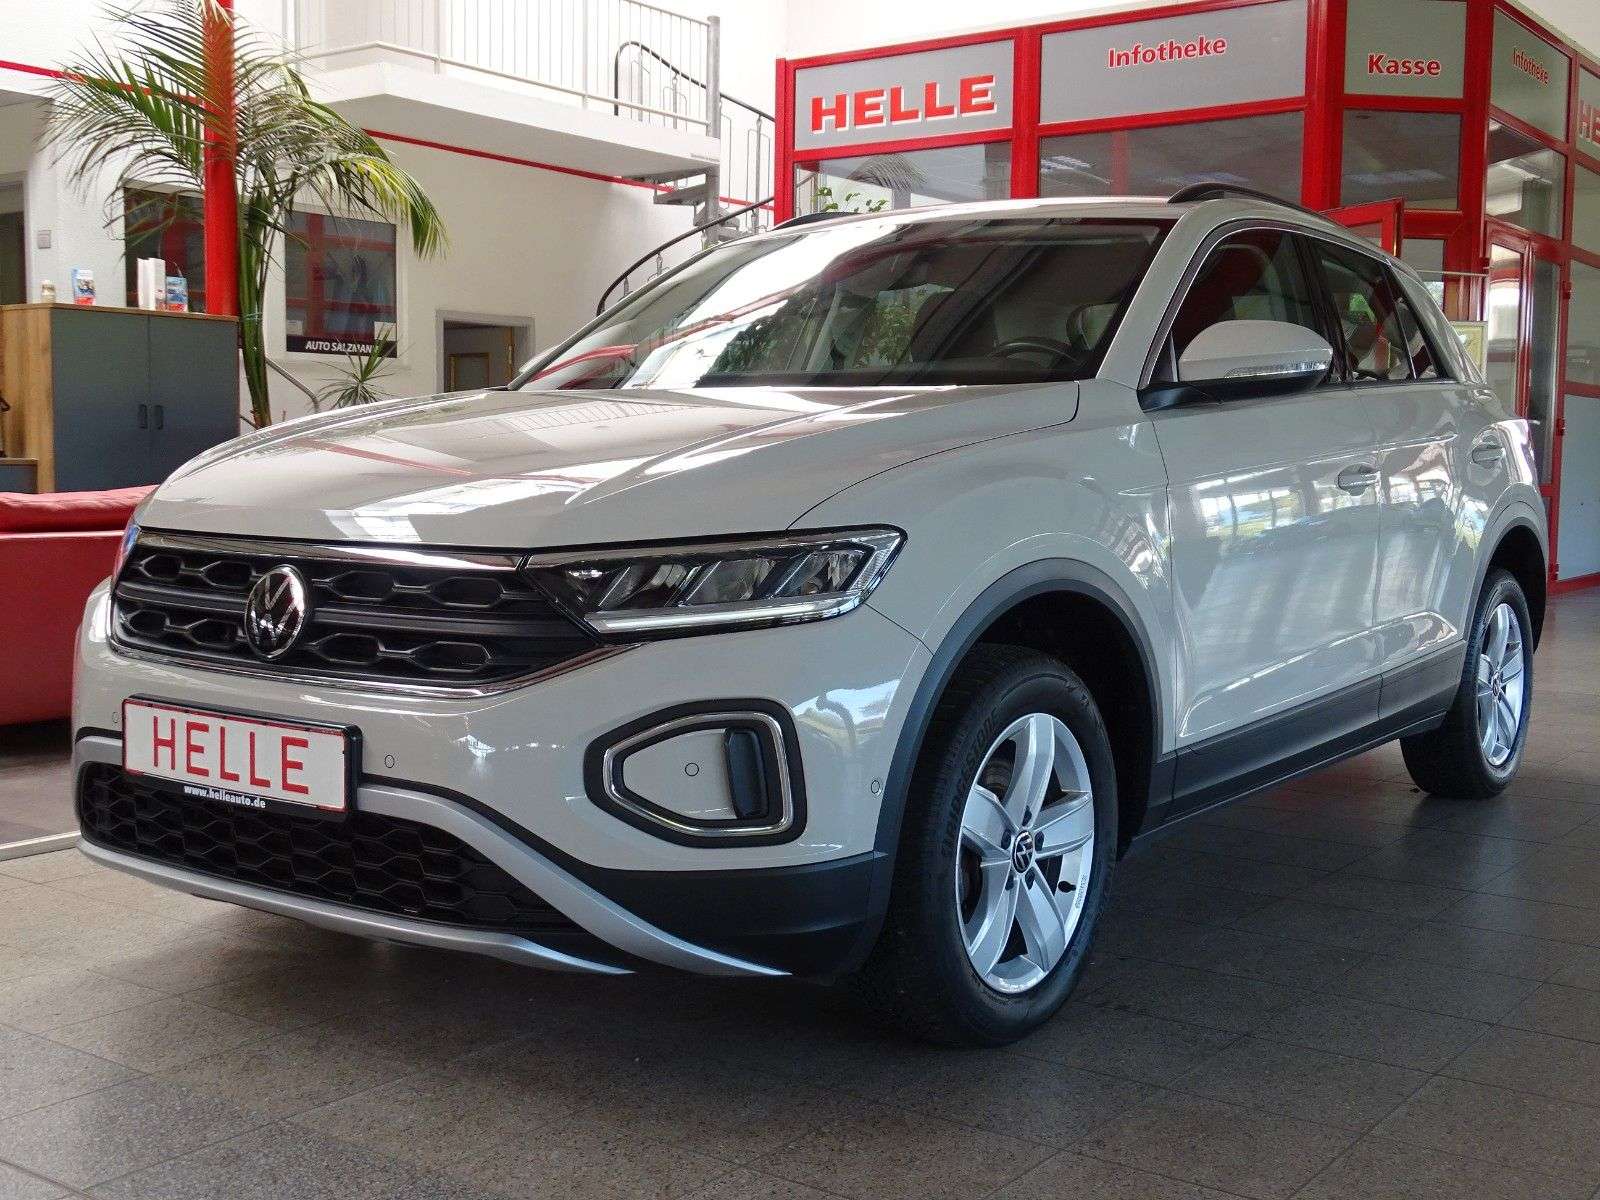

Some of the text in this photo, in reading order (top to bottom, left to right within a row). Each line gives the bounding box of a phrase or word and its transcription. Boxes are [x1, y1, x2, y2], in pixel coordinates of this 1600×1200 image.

[1107, 35, 1227, 70] Infotheke
[1367, 52, 1441, 78] Kasse
[811, 74, 996, 134] HELLE
[305, 340, 378, 354] AUTO SALZMAN
[152, 715, 310, 795] HELLE
[183, 785, 266, 809] www.helleauto.de
